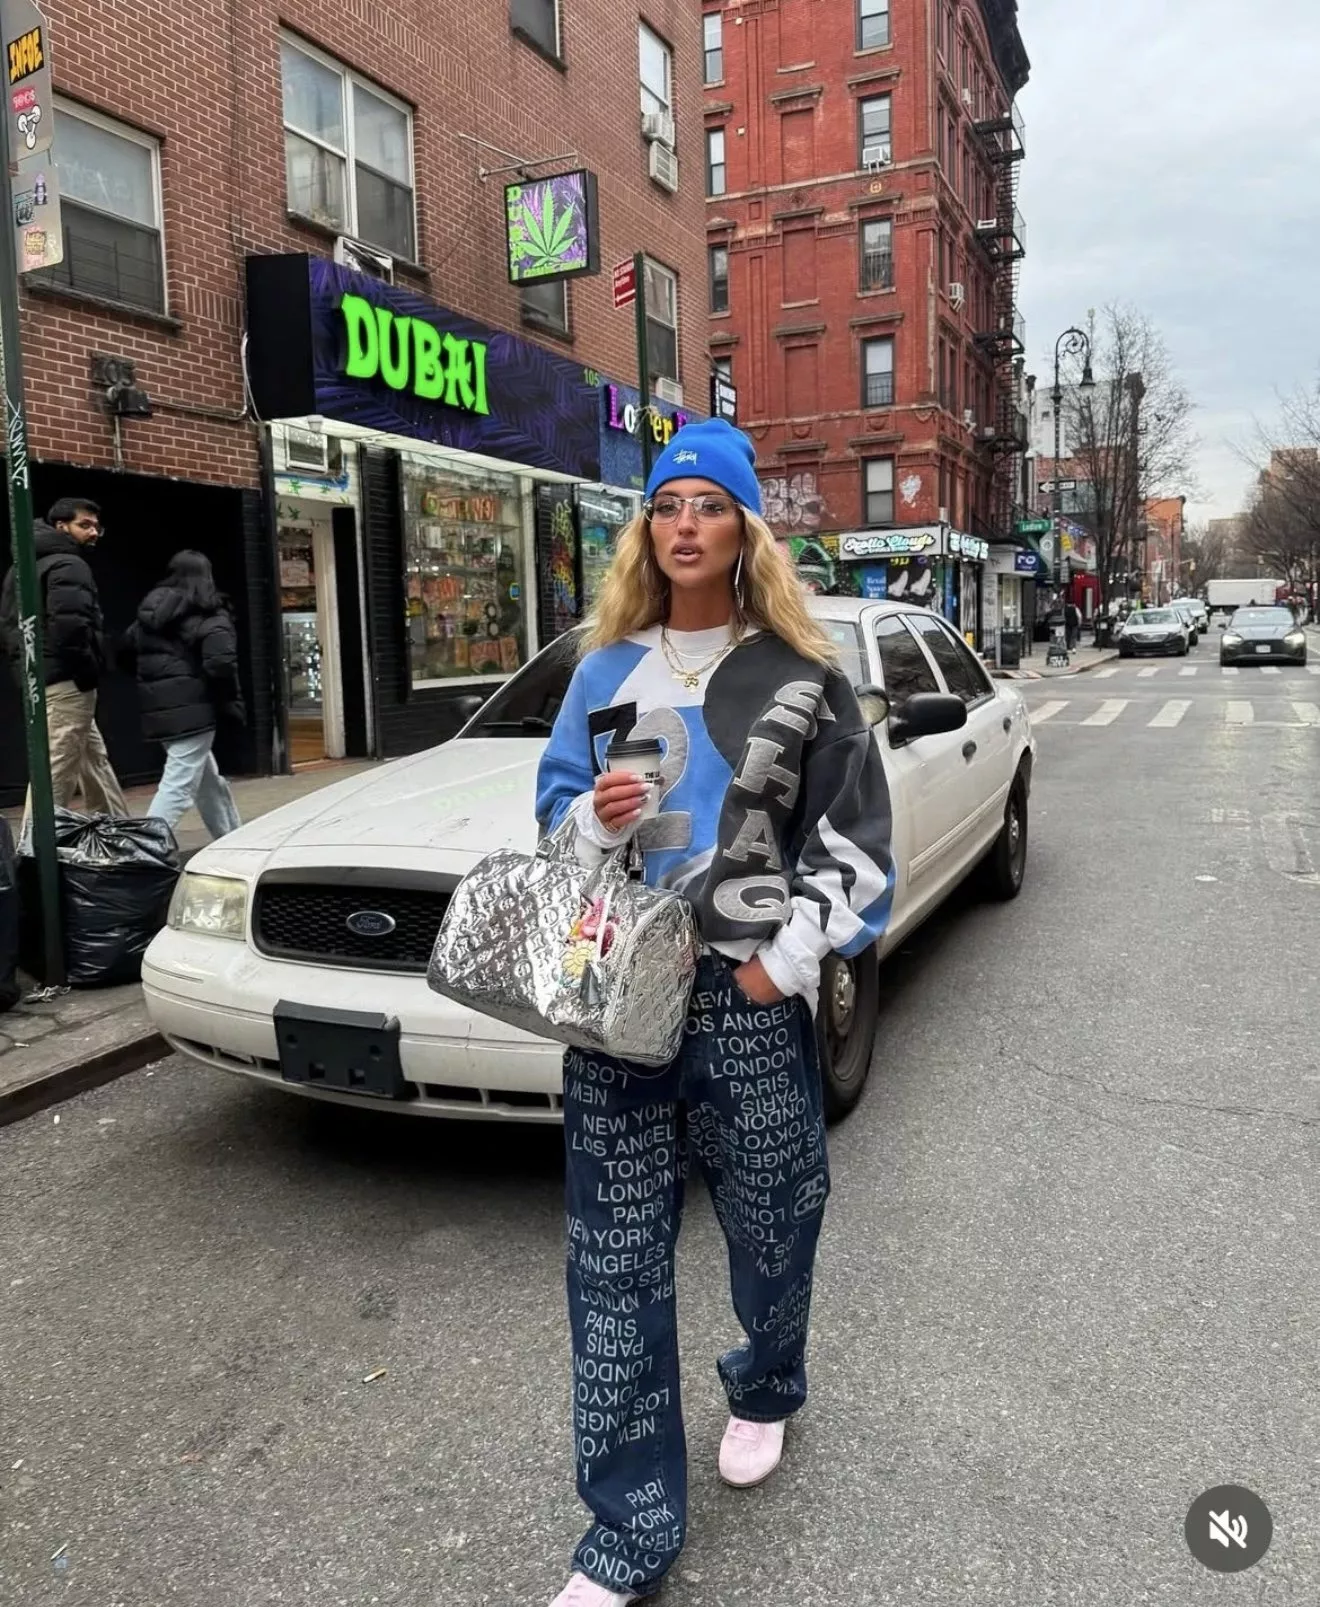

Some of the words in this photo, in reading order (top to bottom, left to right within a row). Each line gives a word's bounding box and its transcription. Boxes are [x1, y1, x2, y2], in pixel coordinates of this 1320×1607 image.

[341, 293, 489, 415] DUBAI
[583, 368, 600, 388] 105
[608, 384, 673, 445] Loer
[684, 1014, 715, 1035] OS
[712, 1028, 789, 1055] TOKYO
[587, 1061, 628, 1089] LOS
[709, 1042, 797, 1080] LONDON
[570, 1081, 608, 1107] NEW
[729, 1071, 790, 1099] PARIS
[741, 1084, 799, 1117] PARIS
[583, 1113, 626, 1135] NEW
[744, 1115, 810, 1150] TOKYO
[572, 1131, 607, 1157] LOS
[614, 1123, 675, 1156] ANGEL
[603, 1147, 669, 1180] TOKYO
[597, 1169, 674, 1202] LONDON
[613, 1194, 665, 1224] PARIS
[592, 1225, 654, 1249] YORK
[580, 1242, 666, 1274] ANGELES
[584, 1310, 637, 1338] PARIS
[586, 1333, 644, 1358] PARIS
[574, 1353, 653, 1382] LONDON
[577, 1380, 640, 1407] TOKYO
[633, 1387, 669, 1415] LOS
[575, 1404, 630, 1432] ANGE
[614, 1416, 655, 1448] NEW
[625, 1478, 666, 1509] PARI
[622, 1503, 675, 1540] YORK
